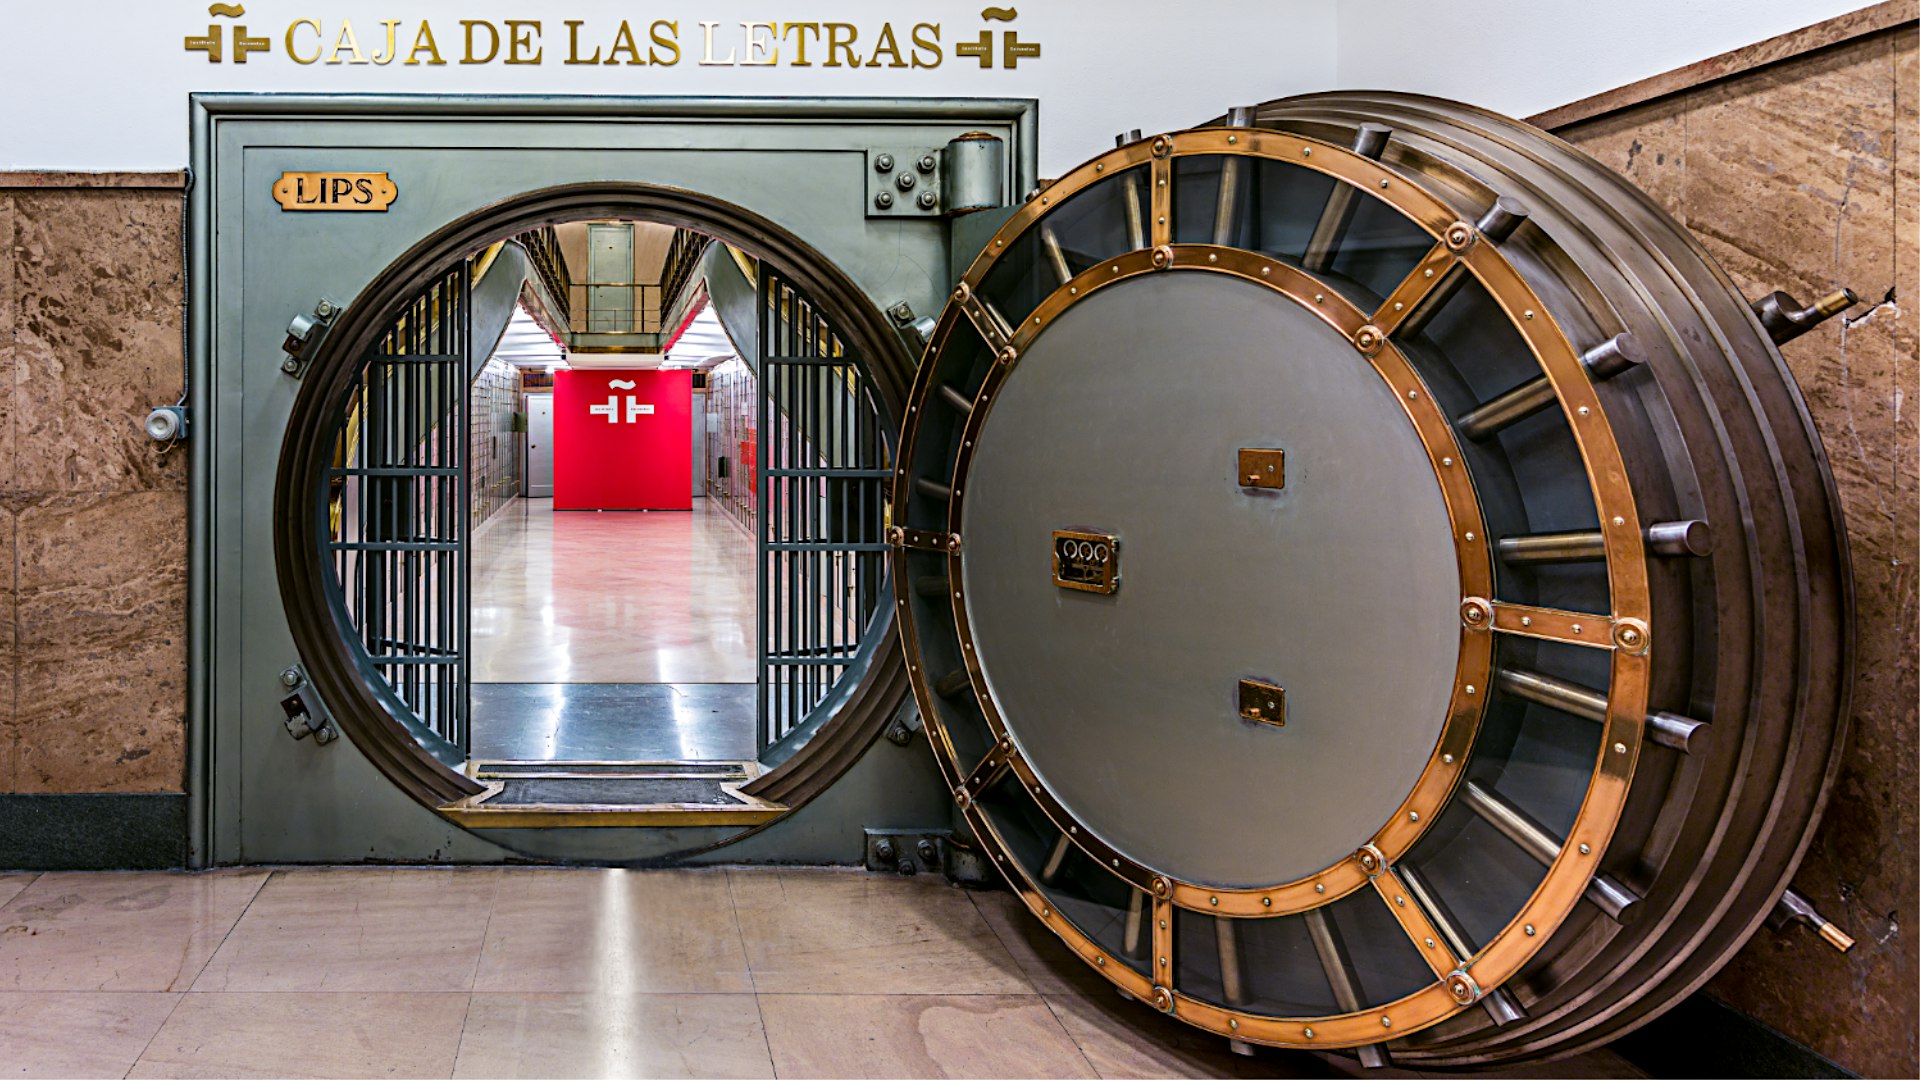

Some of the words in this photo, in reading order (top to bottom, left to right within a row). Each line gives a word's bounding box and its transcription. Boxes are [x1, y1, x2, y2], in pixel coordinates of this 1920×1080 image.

[285, 17, 447, 66] CAJA
[459, 19, 542, 66] DE
[564, 20, 679, 67] LAS
[699, 21, 943, 69] LETRAS
[296, 177, 373, 204] LIPS
